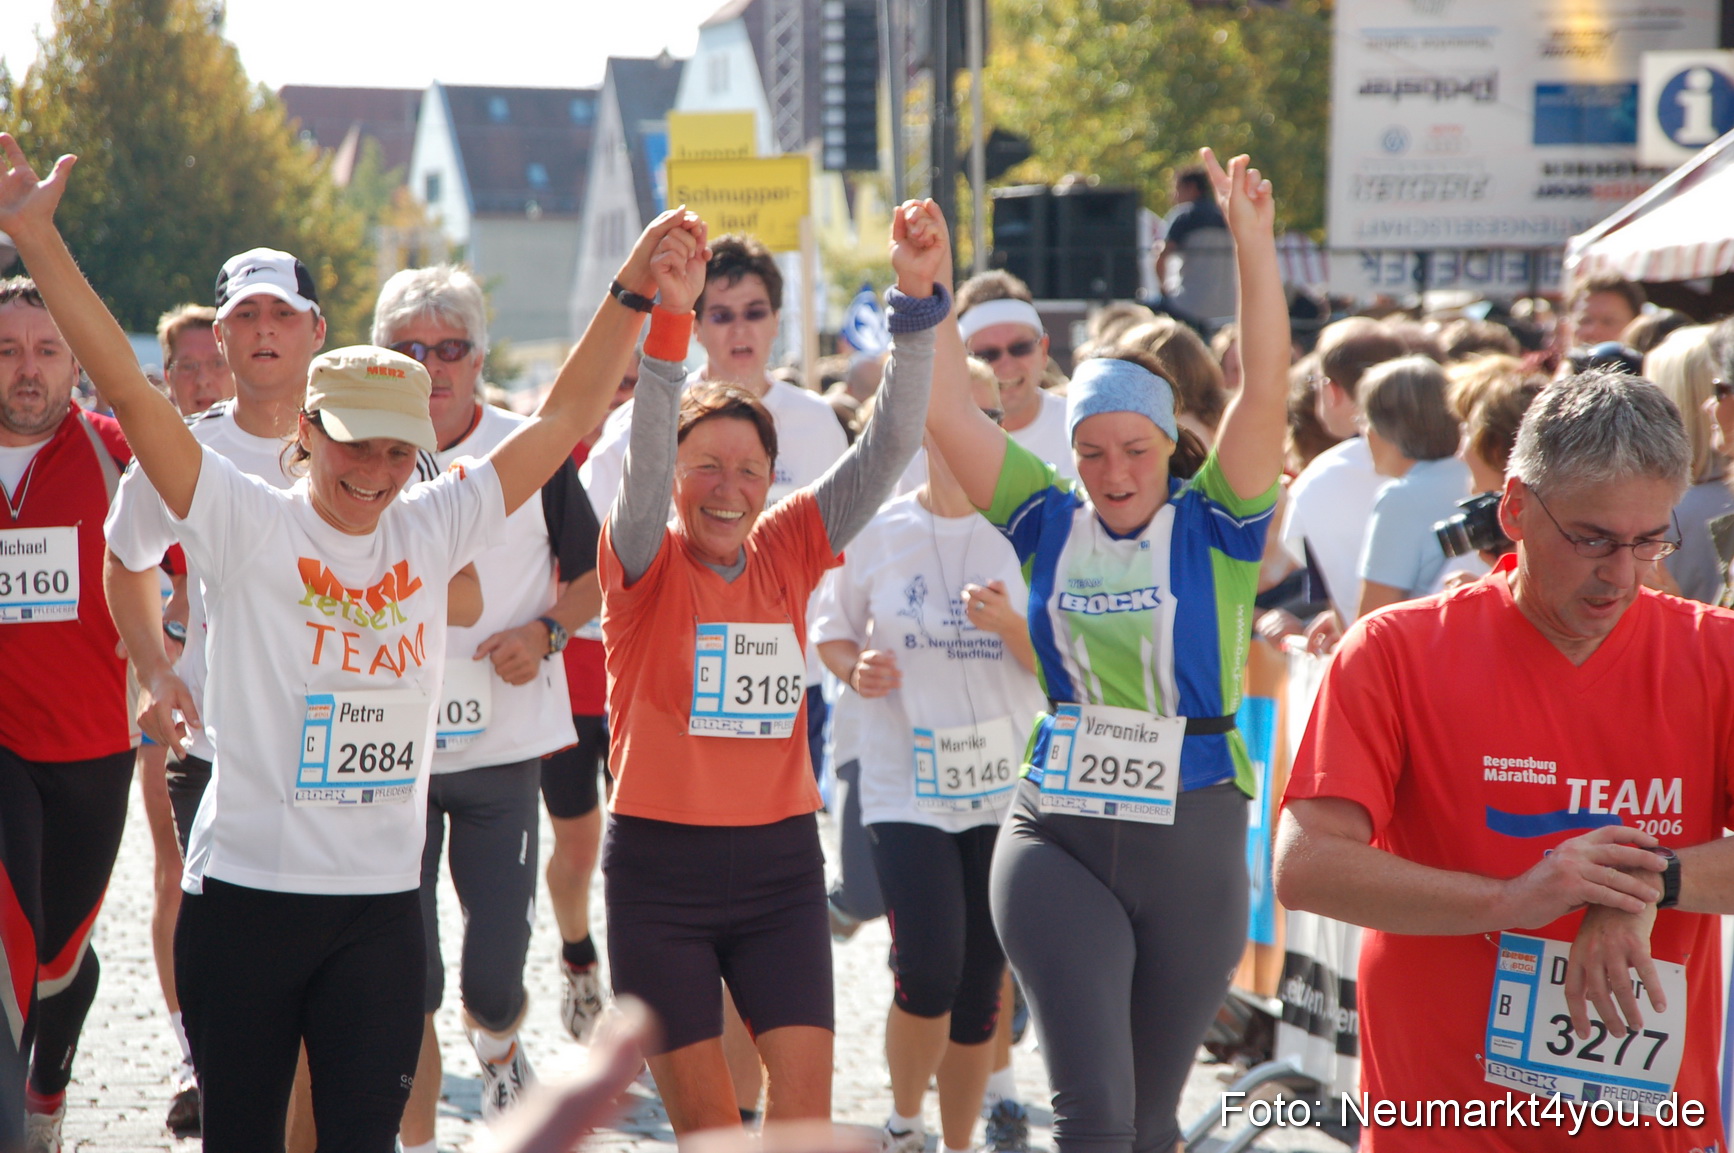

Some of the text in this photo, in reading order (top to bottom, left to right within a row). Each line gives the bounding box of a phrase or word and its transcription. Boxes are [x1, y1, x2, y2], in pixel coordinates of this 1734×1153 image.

[676, 184, 801, 205] Schnupper-
[719, 212, 759, 229] lauf
[0, 570, 69, 596] 3160
[298, 557, 422, 613] MERZ
[298, 585, 407, 630] reisen
[1058, 586, 1162, 615] BOCK
[306, 622, 426, 678] TEAM
[735, 634, 778, 655] Bruni
[904, 635, 1003, 649] 8. Neumarkter
[700, 667, 709, 682] C
[735, 675, 801, 705] 3185
[340, 702, 384, 722] Petra
[1085, 716, 1160, 744] Veronika
[307, 736, 315, 752] C
[940, 735, 986, 753] Marika
[1051, 745, 1060, 760] B
[337, 741, 414, 774] 2684
[1483, 755, 1557, 773] Regensburg
[946, 758, 1011, 790] 3146
[1079, 754, 1166, 791] 2952
[1483, 768, 1557, 785] Marathon
[1566, 778, 1683, 815] TEAM
[1119, 803, 1172, 817] PFLEIDERER
[1635, 819, 1683, 835] 2006
[1499, 994, 1512, 1016] B
[1546, 1014, 1669, 1071] 3277
[1488, 1062, 1557, 1090] BOCK
